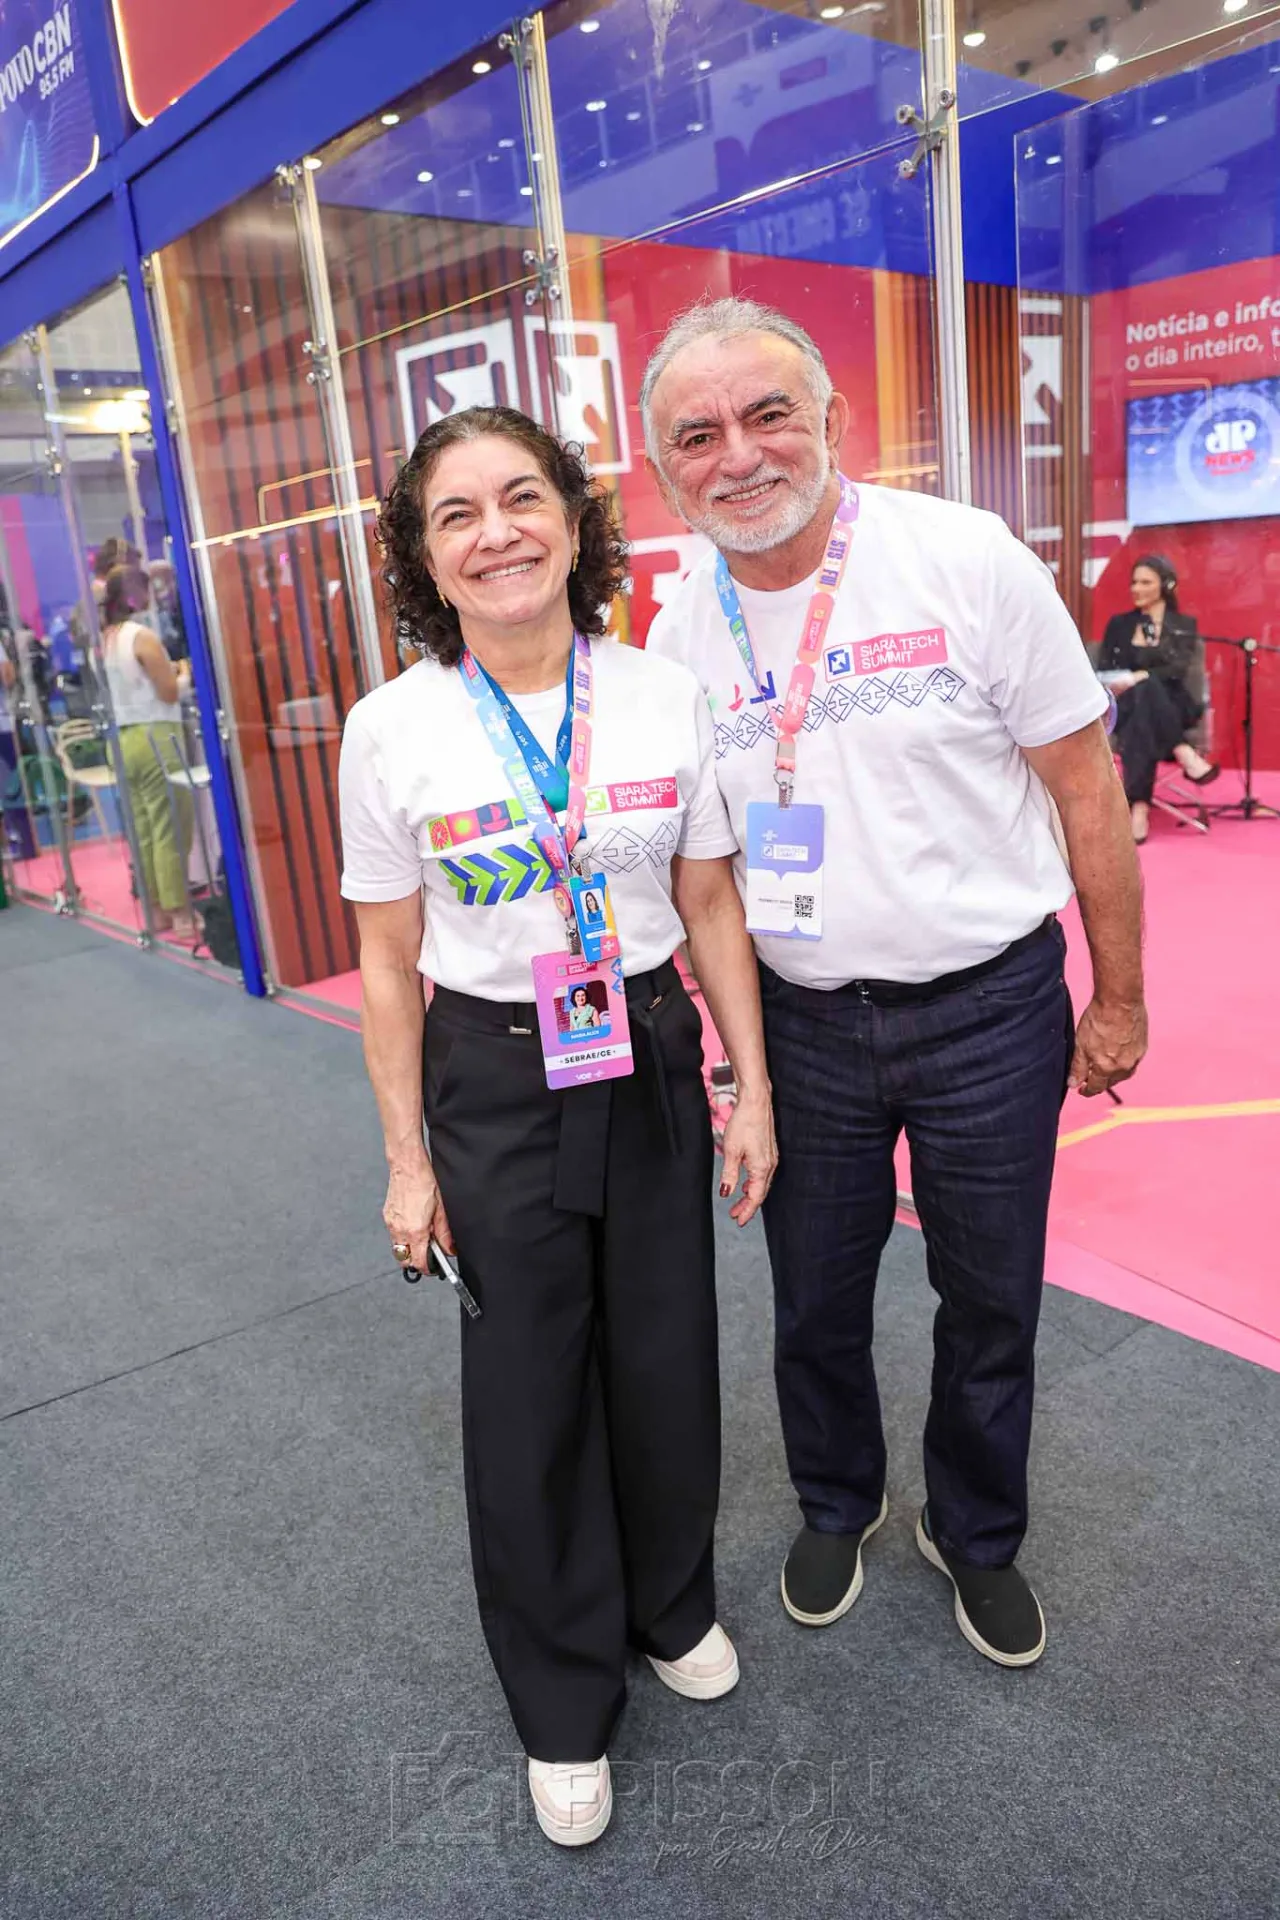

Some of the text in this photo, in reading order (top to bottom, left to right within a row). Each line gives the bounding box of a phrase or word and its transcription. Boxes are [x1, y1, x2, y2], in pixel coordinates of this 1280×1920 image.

[33, 3, 72, 73] CBN
[59, 51, 75, 83] FM
[1126, 311, 1209, 344] Notícia
[1214, 310, 1229, 328] e
[1125, 354, 1140, 371] o
[1144, 346, 1178, 368] dia
[1184, 332, 1265, 361] inteiro,
[900, 633, 939, 650] TECH
[861, 651, 914, 670] SUMMIT
[651, 781, 677, 793] TECH
[616, 793, 664, 808] SUMMIT
[564, 1049, 611, 1064] SEBRAE/CE
